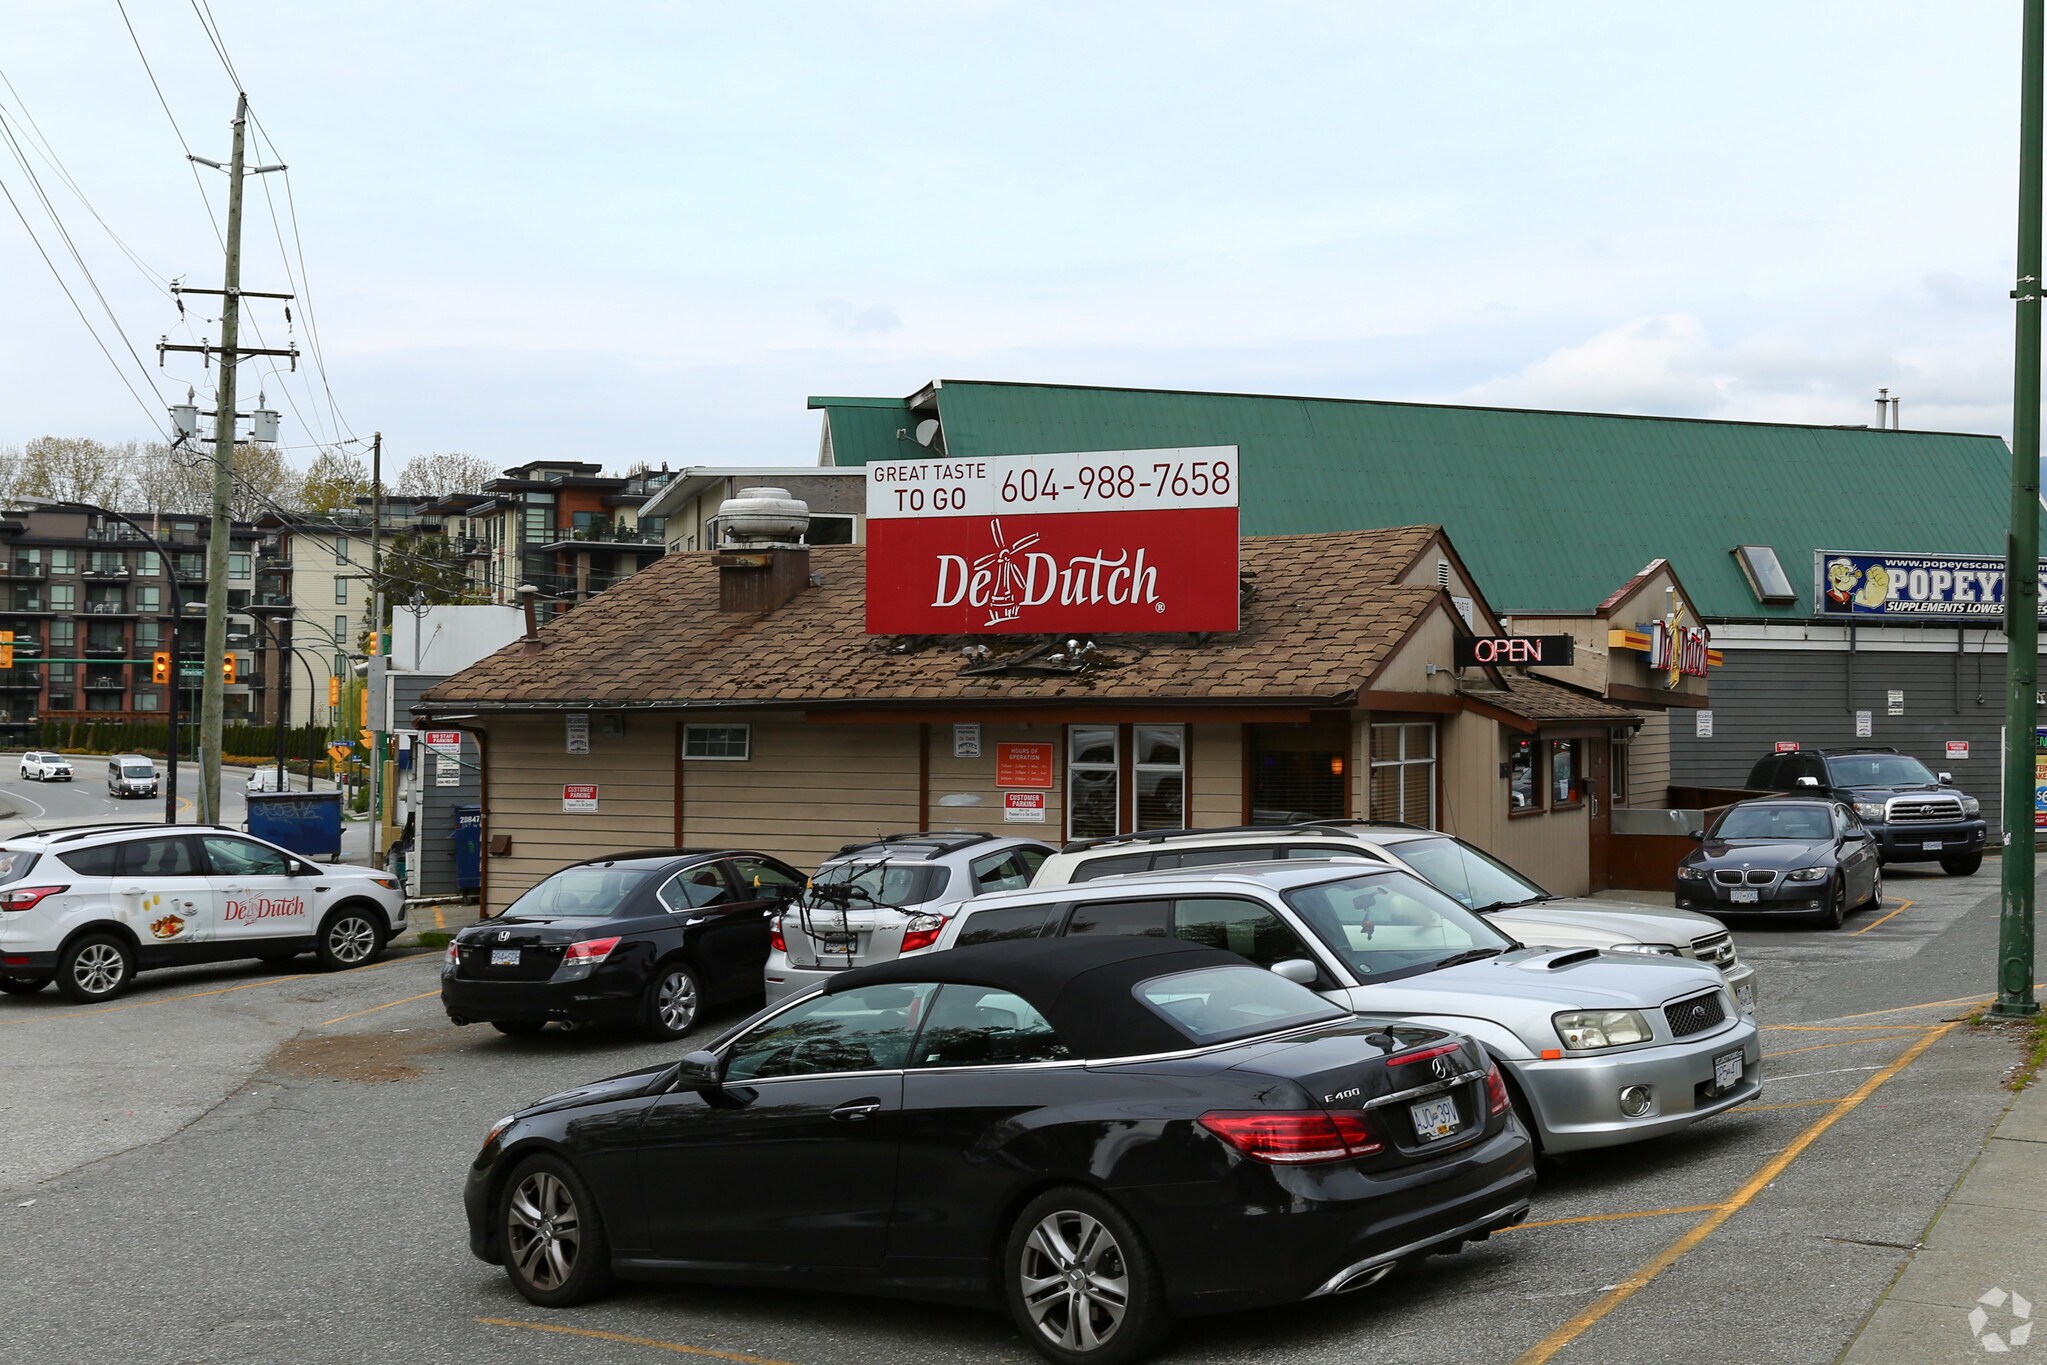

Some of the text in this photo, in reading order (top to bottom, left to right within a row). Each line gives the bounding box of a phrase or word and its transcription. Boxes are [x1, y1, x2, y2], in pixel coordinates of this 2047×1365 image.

[874, 463, 986, 482] GREAT TASTE
[1001, 460, 1230, 503] 604-988-7658
[894, 487, 966, 511] TO GO
[930, 547, 1160, 608] De Dutch
[1886, 601, 2005, 615] SUPPLEMENTS LOWES
[1474, 639, 1542, 662] OPEN
[224, 895, 305, 920] De Dutch
